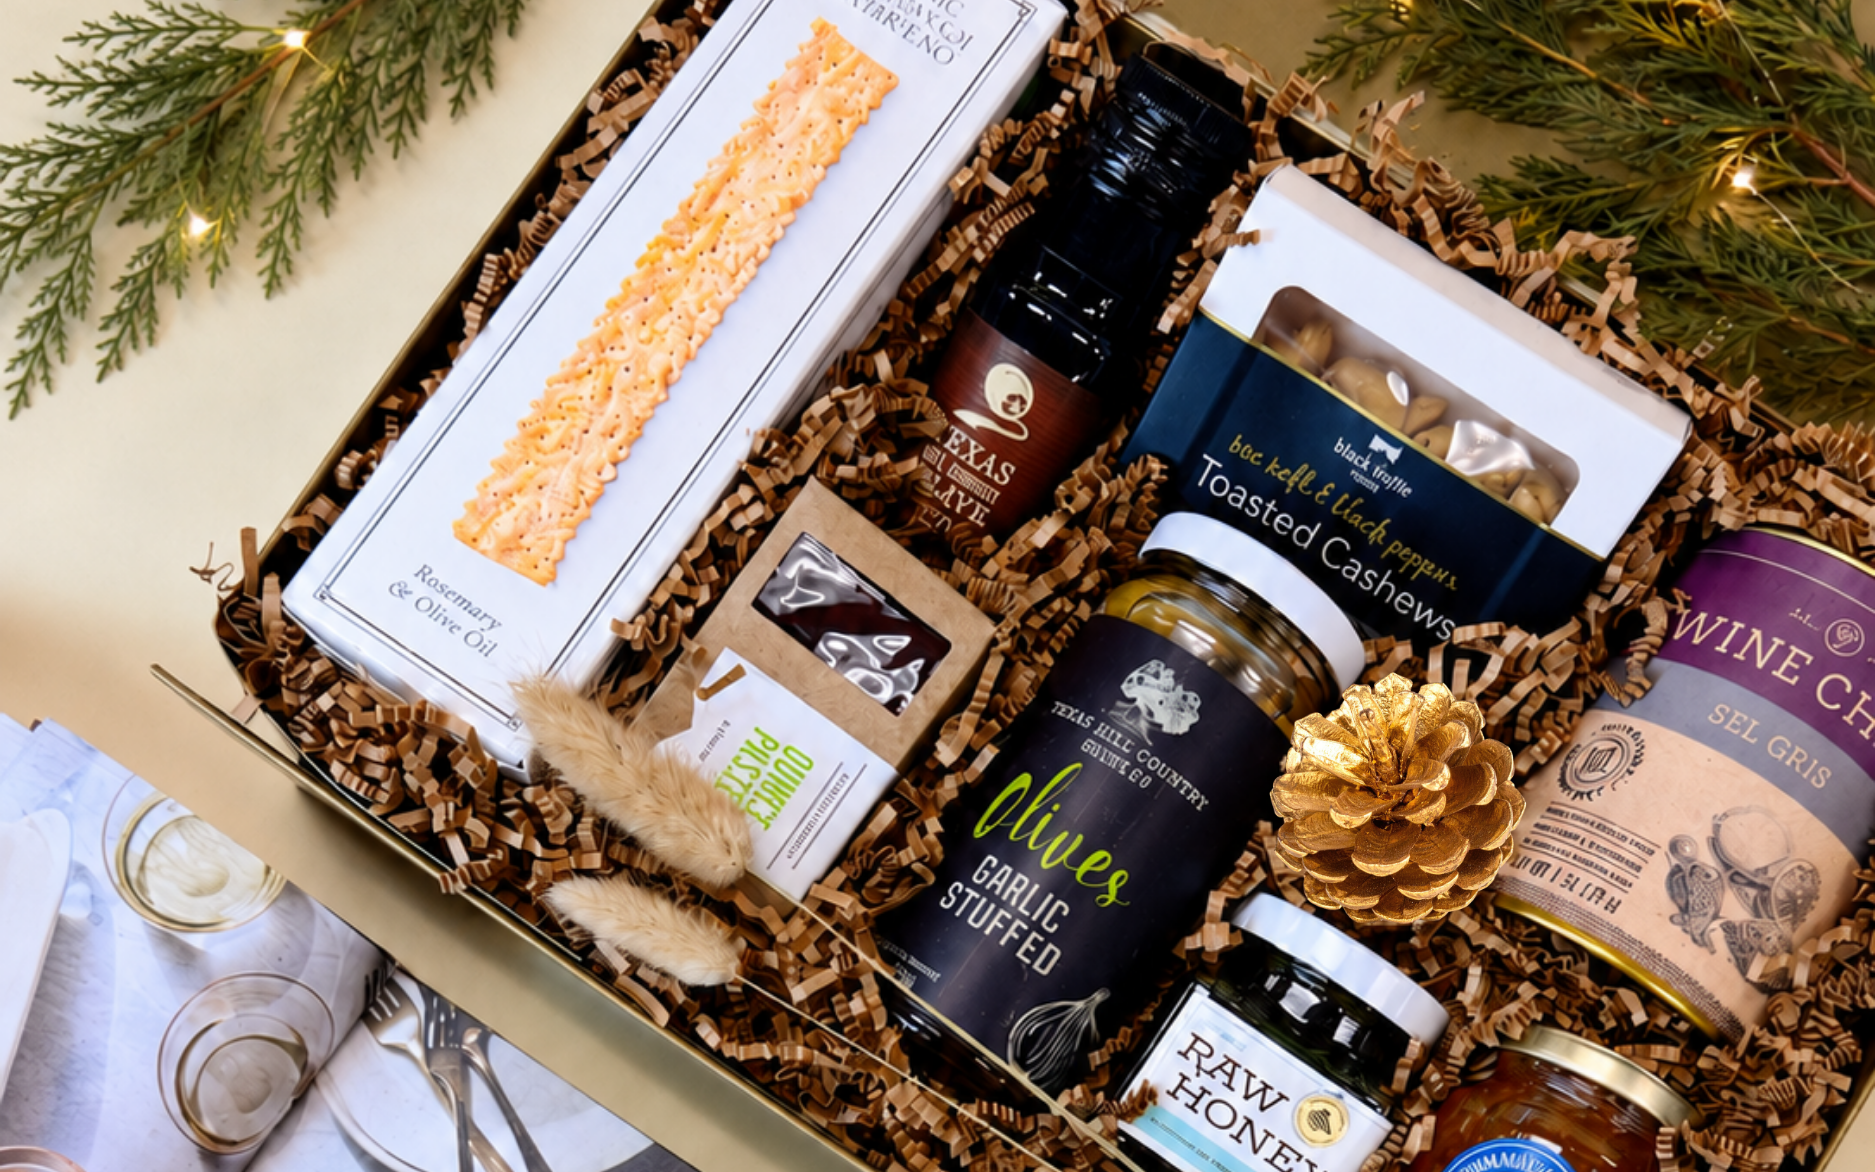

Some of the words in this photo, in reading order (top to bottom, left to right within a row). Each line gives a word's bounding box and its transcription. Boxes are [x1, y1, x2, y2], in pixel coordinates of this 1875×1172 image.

[942, 425, 1016, 485] EXAS
[1197, 453, 1321, 549] Toasted
[1322, 536, 1456, 640] Cashews
[389, 580, 413, 600] &
[414, 596, 461, 634] Olive
[464, 630, 498, 657] Oil
[414, 564, 502, 632] Rosemary
[1673, 609, 1814, 686] WINE
[1816, 673, 1875, 748] CH
[1051, 701, 1096, 729] TEXAS
[1136, 749, 1209, 812] COUNTRY
[1707, 703, 1760, 744] SEL
[1767, 735, 1832, 789] GRIS
[973, 763, 1130, 907] Olives
[940, 882, 1062, 977] STUFFED
[971, 854, 1070, 934] GARLIC
[1177, 1032, 1290, 1113] RAW
